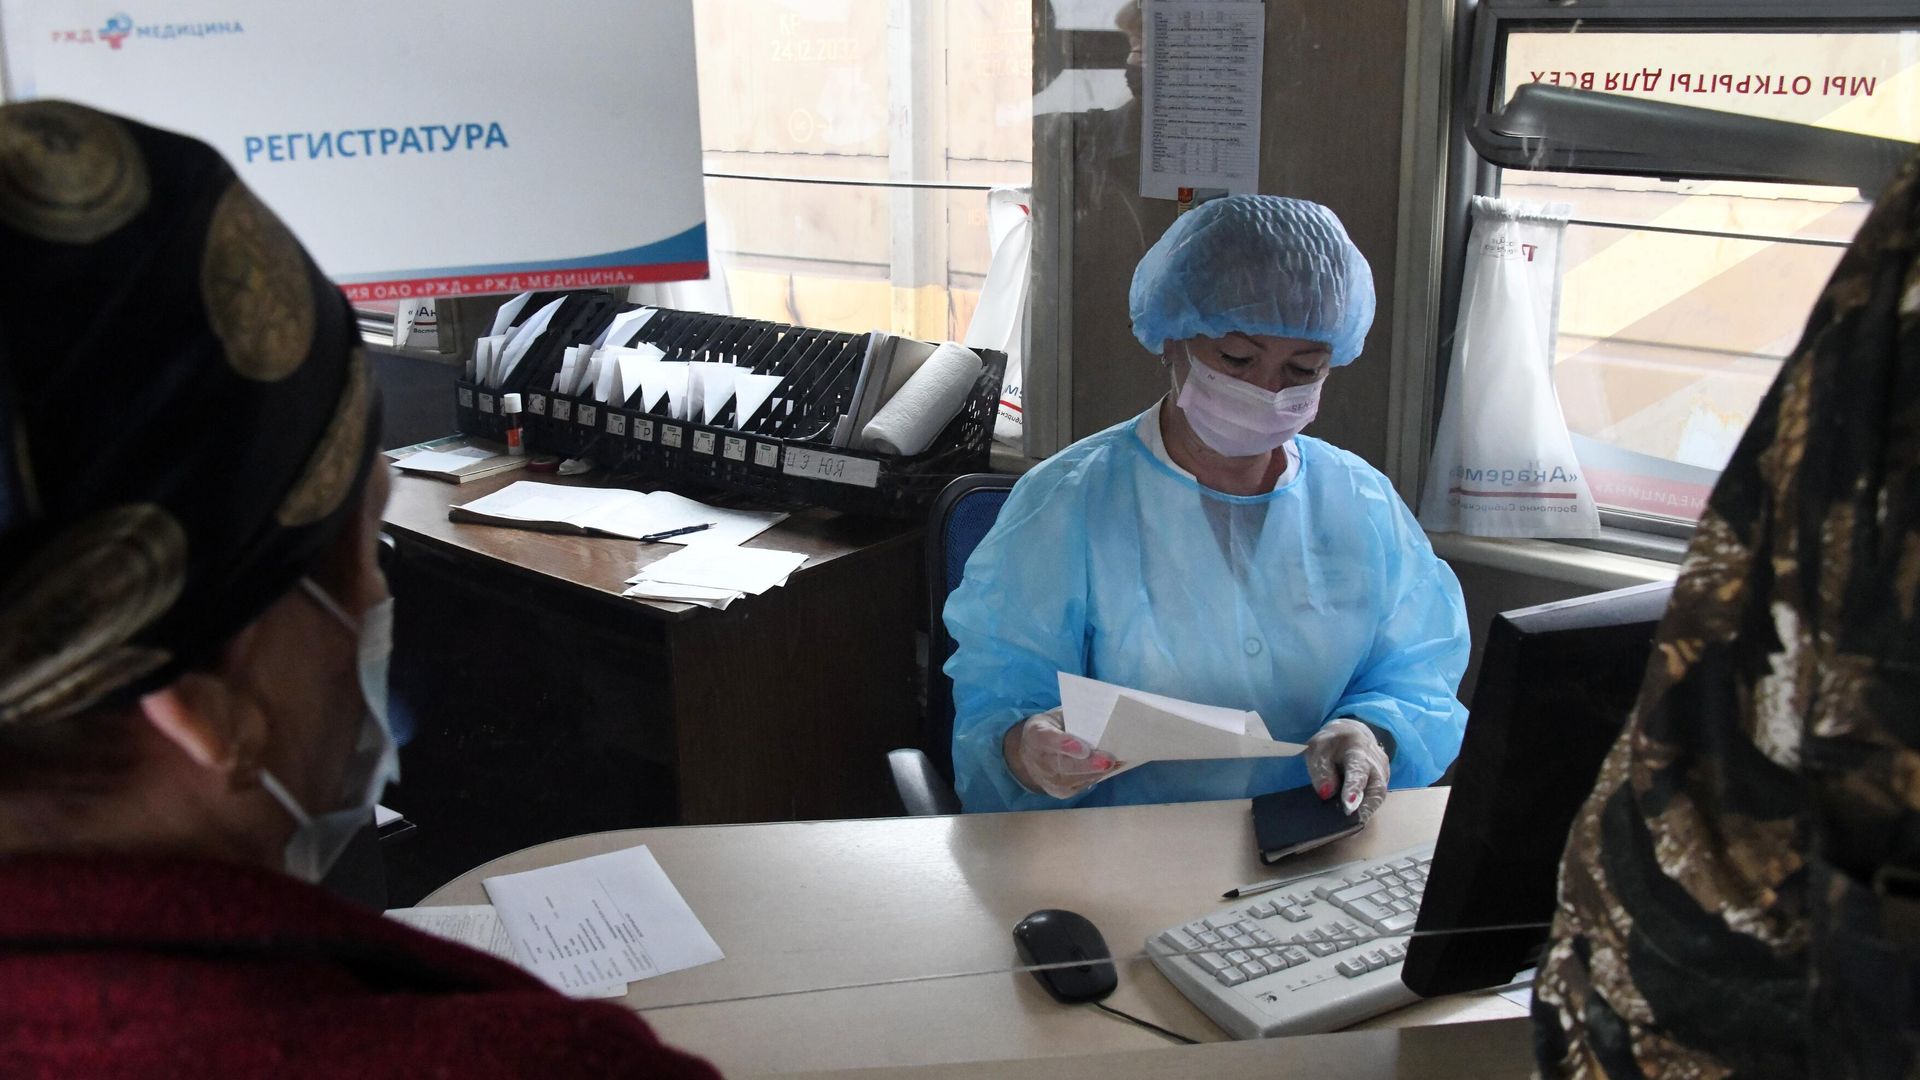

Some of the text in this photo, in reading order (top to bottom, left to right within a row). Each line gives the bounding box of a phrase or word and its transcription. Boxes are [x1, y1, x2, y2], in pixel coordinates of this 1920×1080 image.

[52, 21, 244, 43] РЖД МЕДИЦИНА
[1604, 68, 1662, 91] ДЛЯ
[1669, 73, 1812, 95] ОТКРЫТЫ
[1823, 76, 1876, 96] МЫ
[244, 121, 509, 163] РЕГИСТРАТУРА
[374, 284, 412, 299] ОАО
[416, 280, 470, 295] «РЖД»
[475, 270, 634, 291] «РЖД-МЕДИЦИНА»
